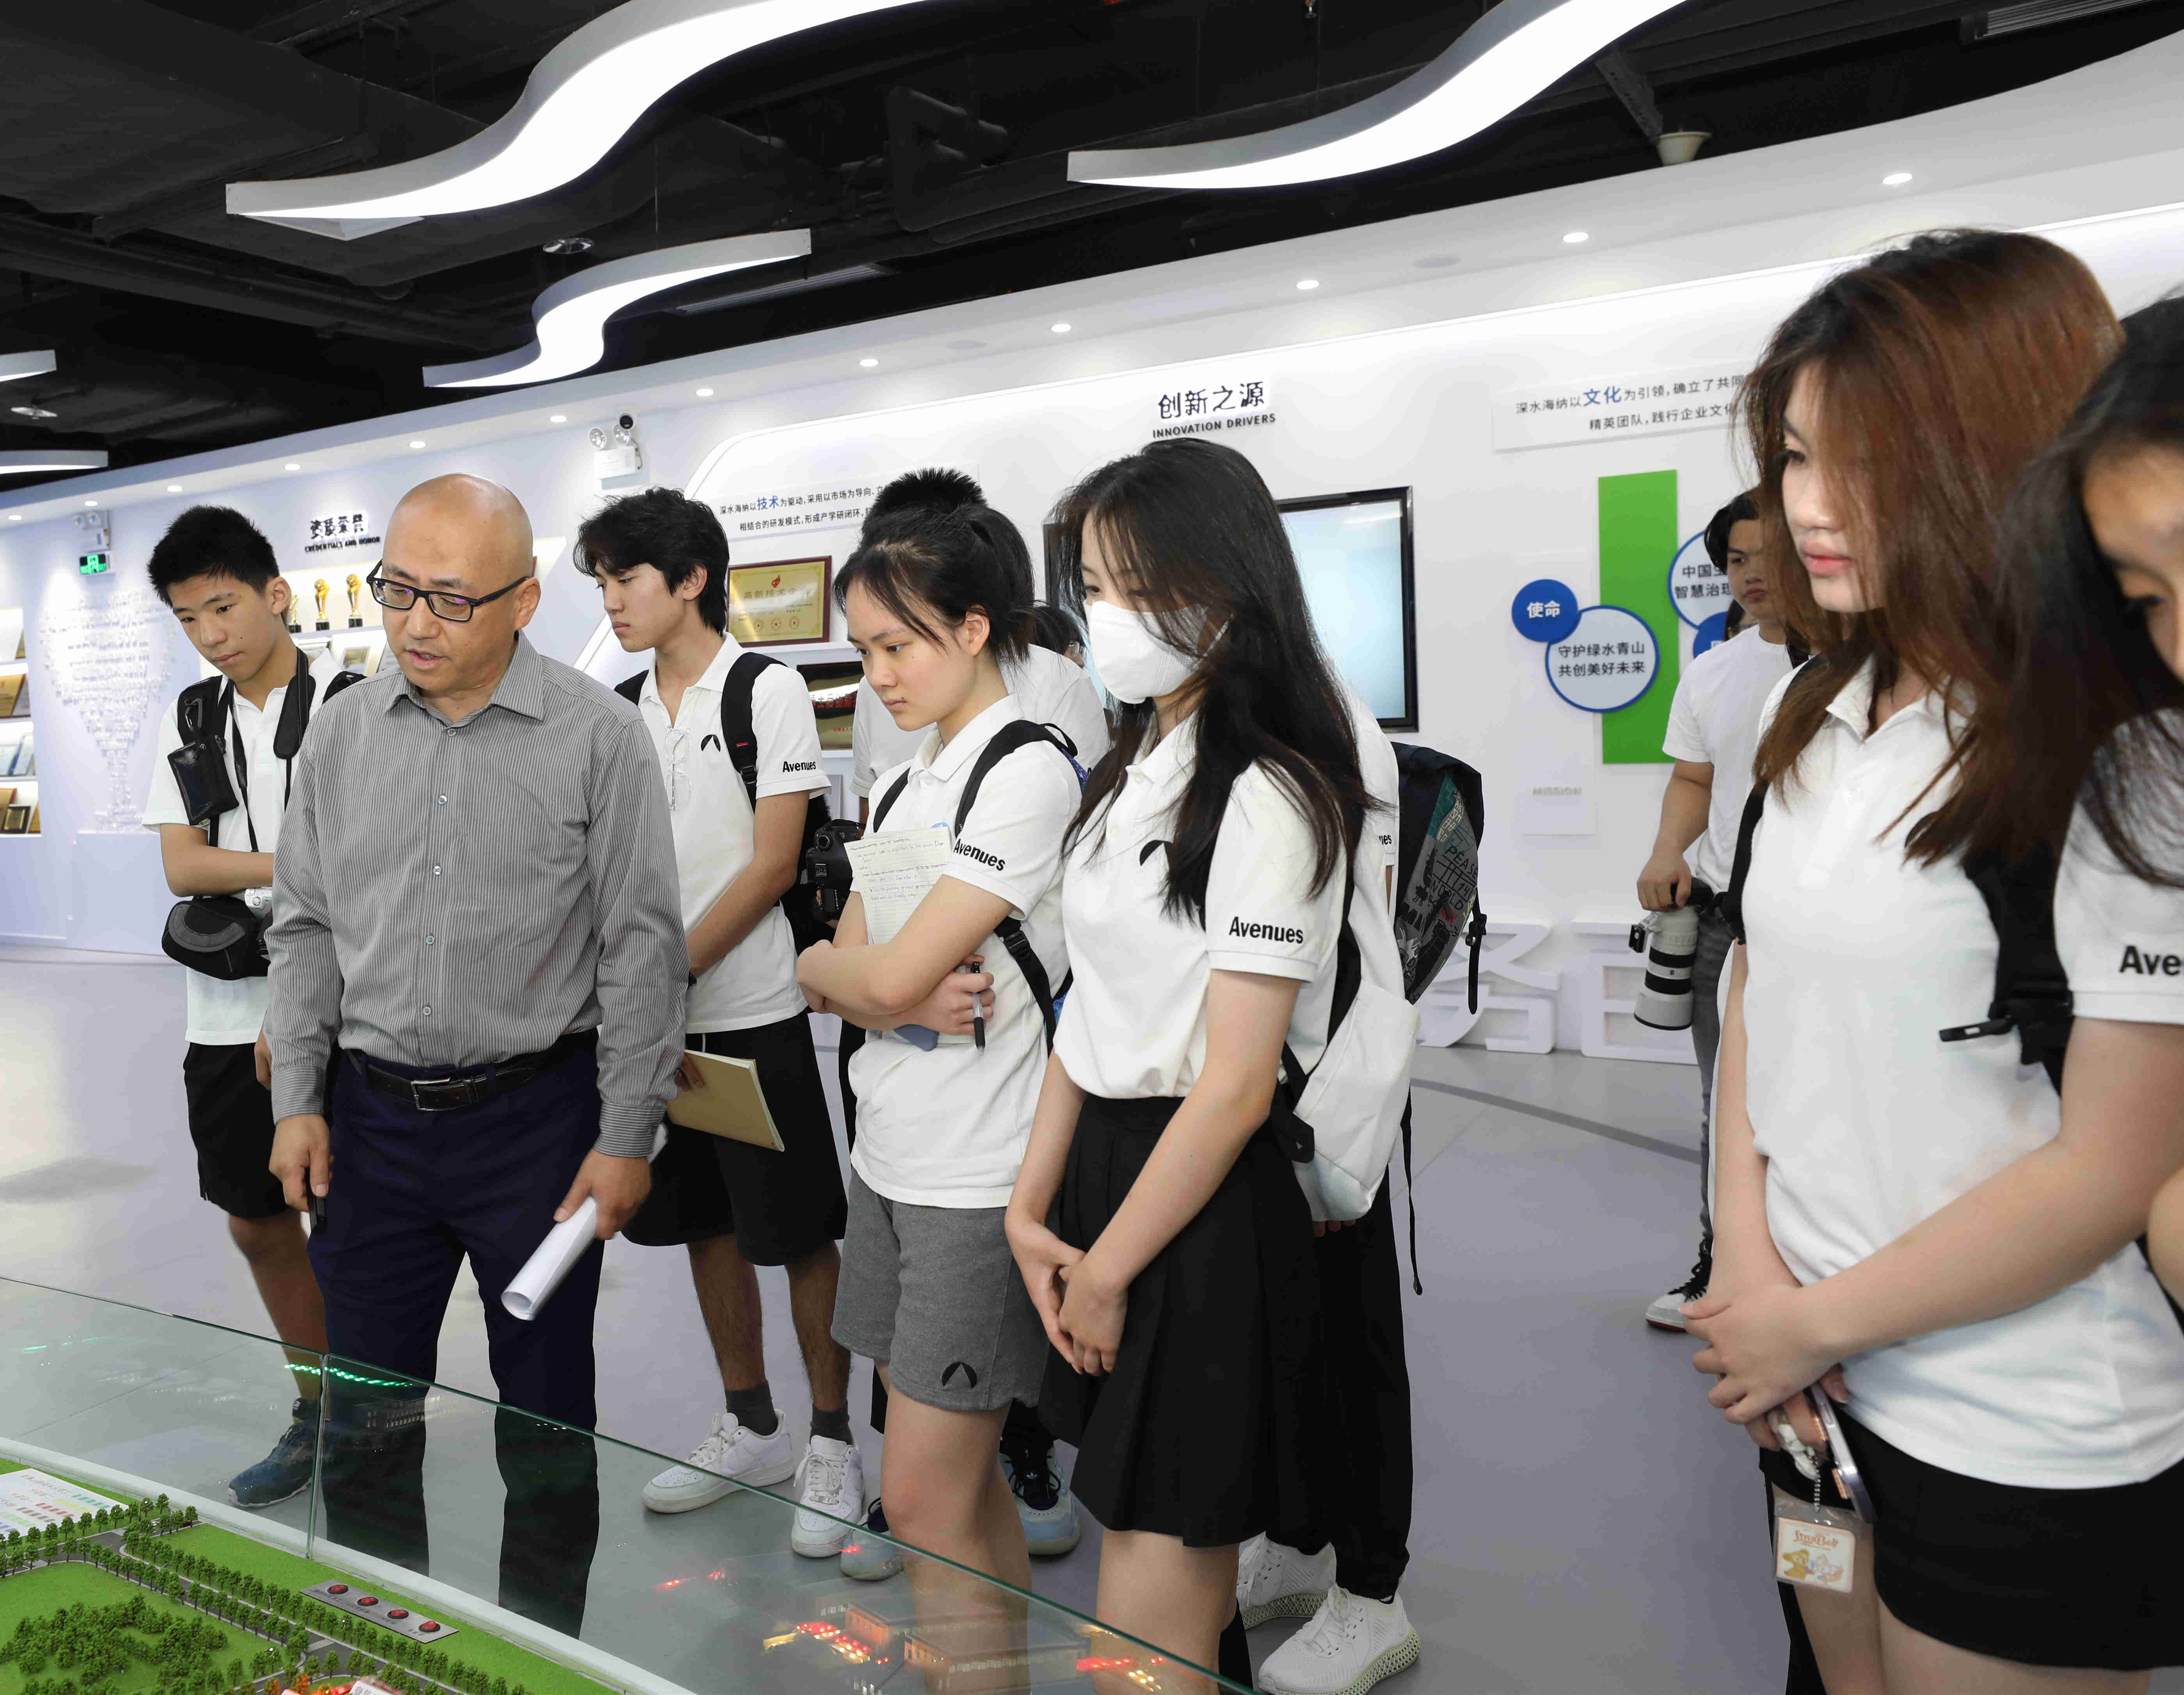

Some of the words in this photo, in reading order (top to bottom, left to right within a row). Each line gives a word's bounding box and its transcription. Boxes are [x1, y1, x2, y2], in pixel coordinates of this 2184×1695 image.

[1158, 381, 1265, 419] 创新之源
[1153, 421, 1222, 438] INNOVATION
[1226, 413, 1276, 428] DRIVERS
[743, 586, 809, 600] 高新技术企
[1527, 601, 1560, 618] 使命
[1558, 642, 1645, 658] 守护绿水青山
[1558, 661, 1645, 677] 共创美好未来
[782, 760, 816, 773] Avenues
[953, 839, 1006, 871] Avenues
[1229, 916, 1303, 944] Avenues
